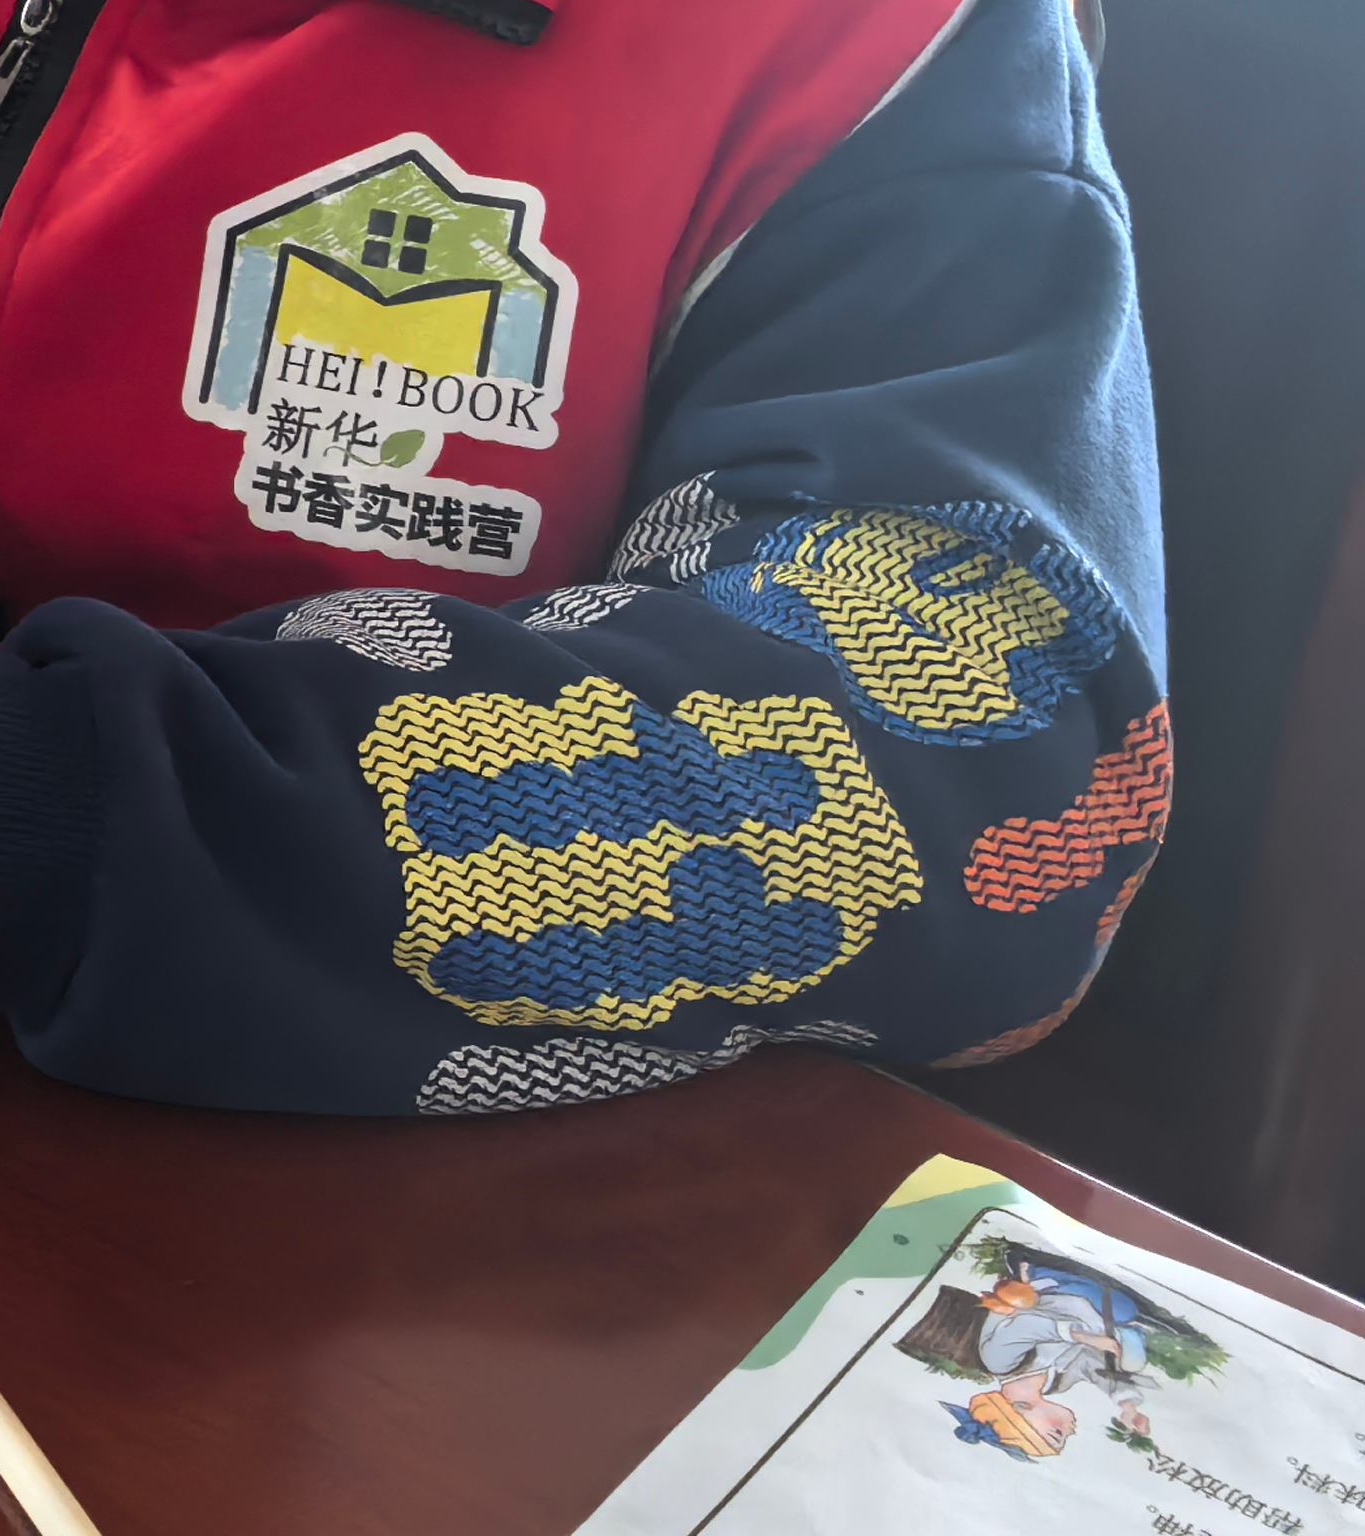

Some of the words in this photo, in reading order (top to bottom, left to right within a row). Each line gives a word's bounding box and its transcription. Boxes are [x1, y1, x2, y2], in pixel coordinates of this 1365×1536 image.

[262, 398, 378, 466] 新华
[276, 344, 546, 432] HEI!BOOK
[252, 460, 523, 559] 书香实践营
